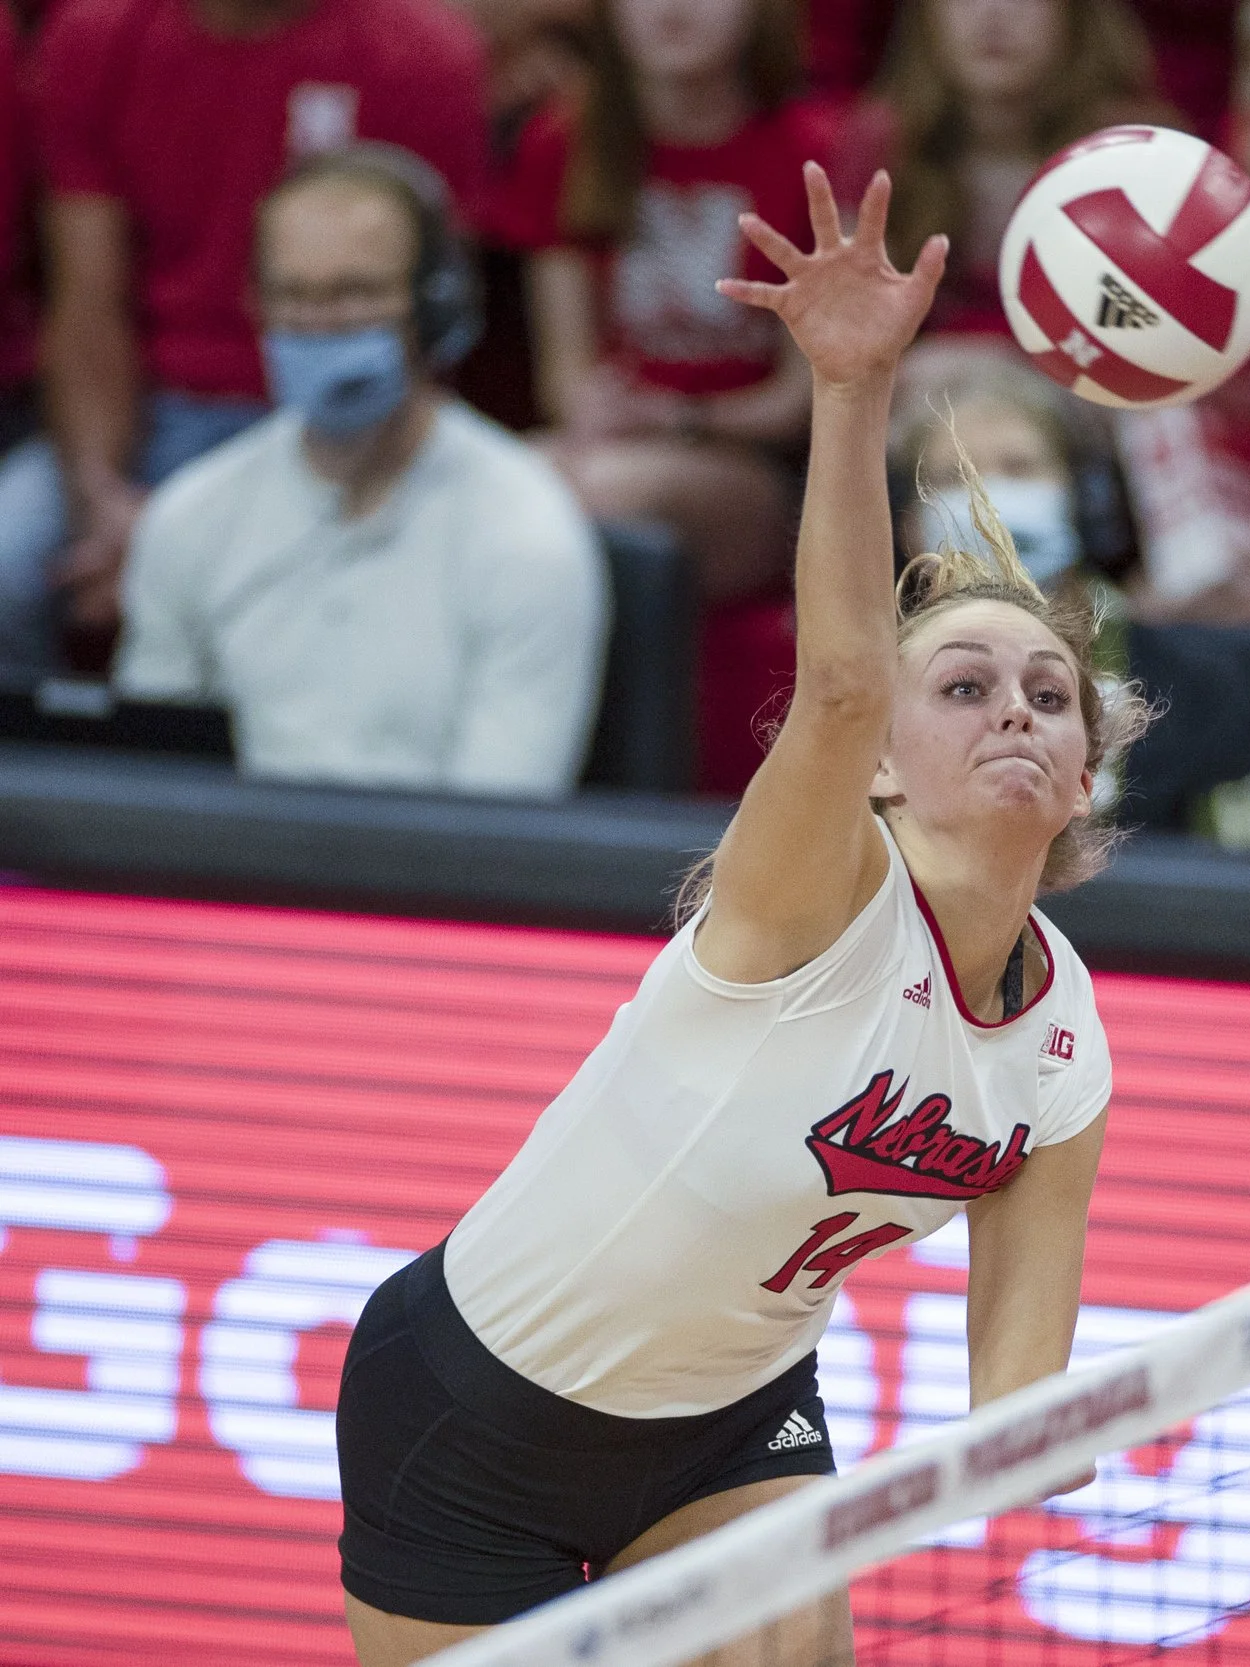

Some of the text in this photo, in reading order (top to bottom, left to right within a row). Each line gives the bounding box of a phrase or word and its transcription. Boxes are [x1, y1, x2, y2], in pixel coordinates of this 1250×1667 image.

[807, 1068, 1030, 1195] Nebrask
[760, 1211, 914, 1294] 14
[768, 1430, 822, 1450] adidas
